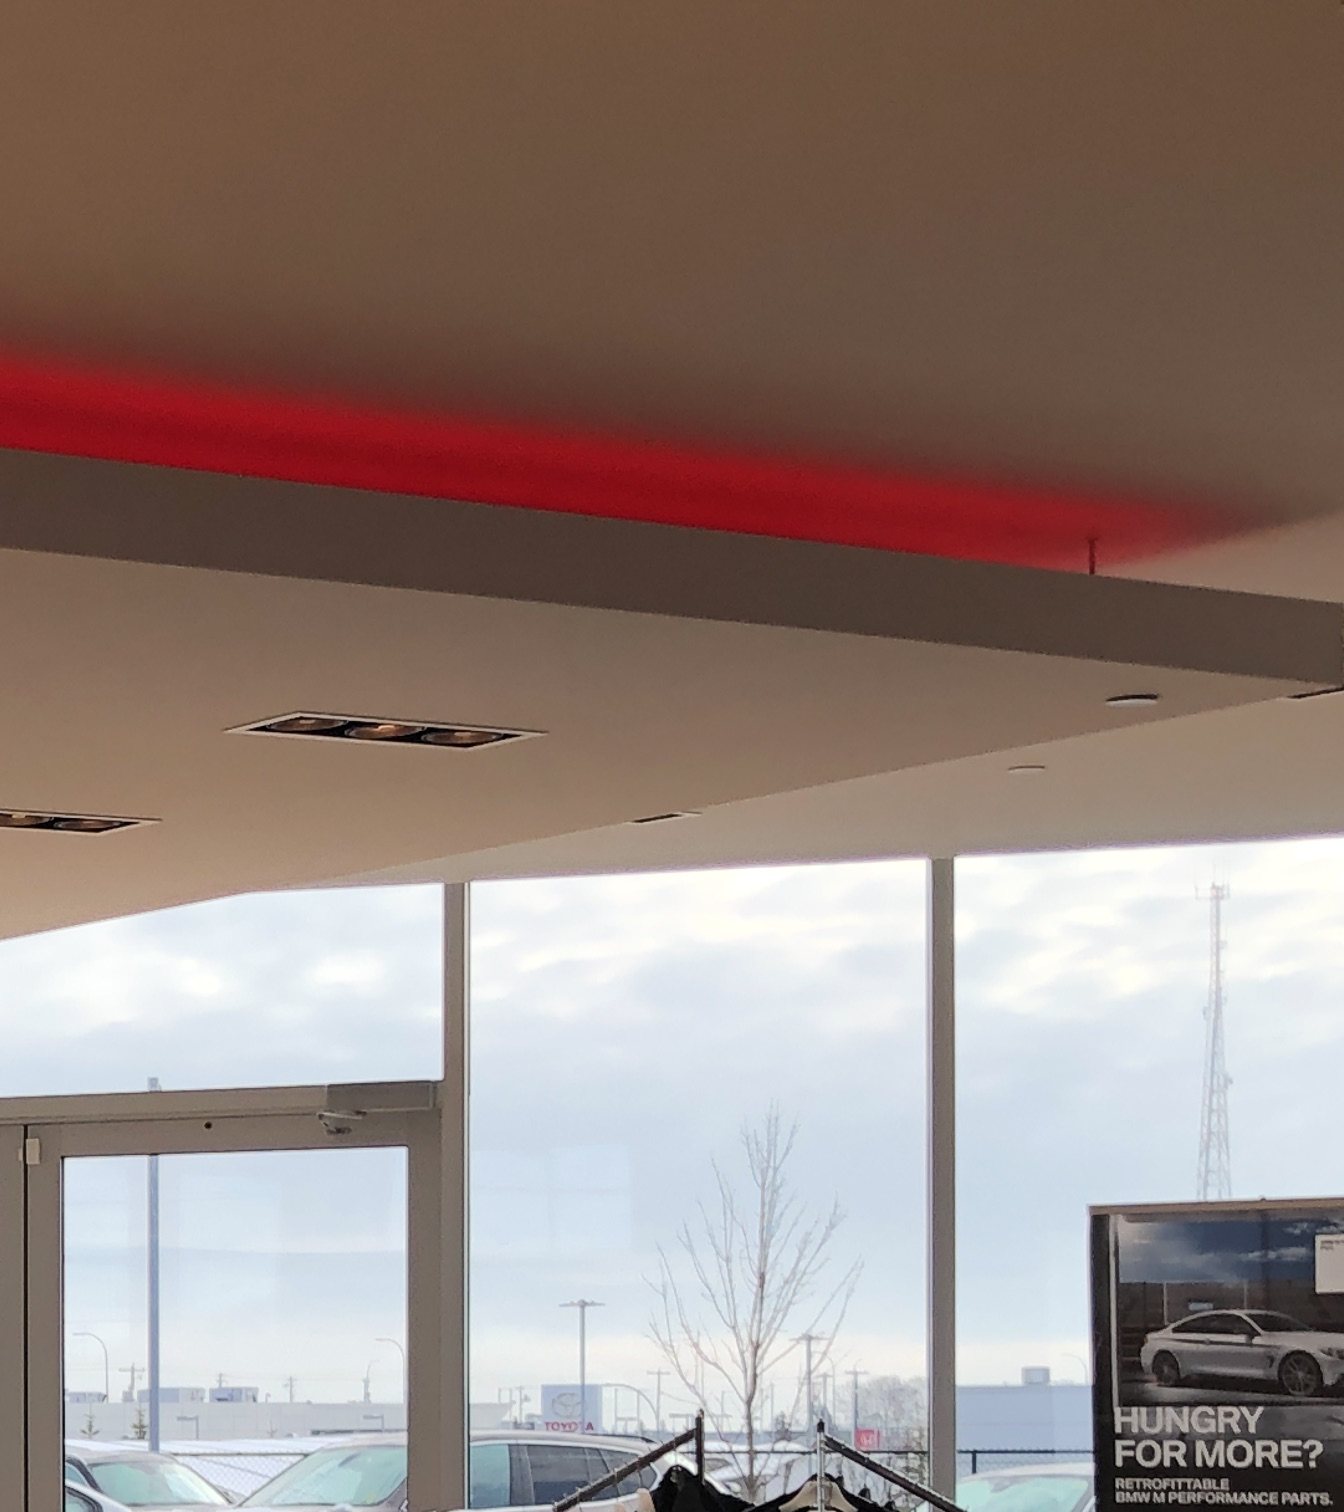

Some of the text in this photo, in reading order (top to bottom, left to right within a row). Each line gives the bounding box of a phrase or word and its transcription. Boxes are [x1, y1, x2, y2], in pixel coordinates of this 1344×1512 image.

[1114, 1405, 1265, 1434] HUNGRY
[1114, 1438, 1325, 1469] FOR MORE?
[1114, 1477, 1230, 1491] RETROFITTABLE
[1115, 1491, 1334, 1506] BMW M PERFORMANCE PARTS.
